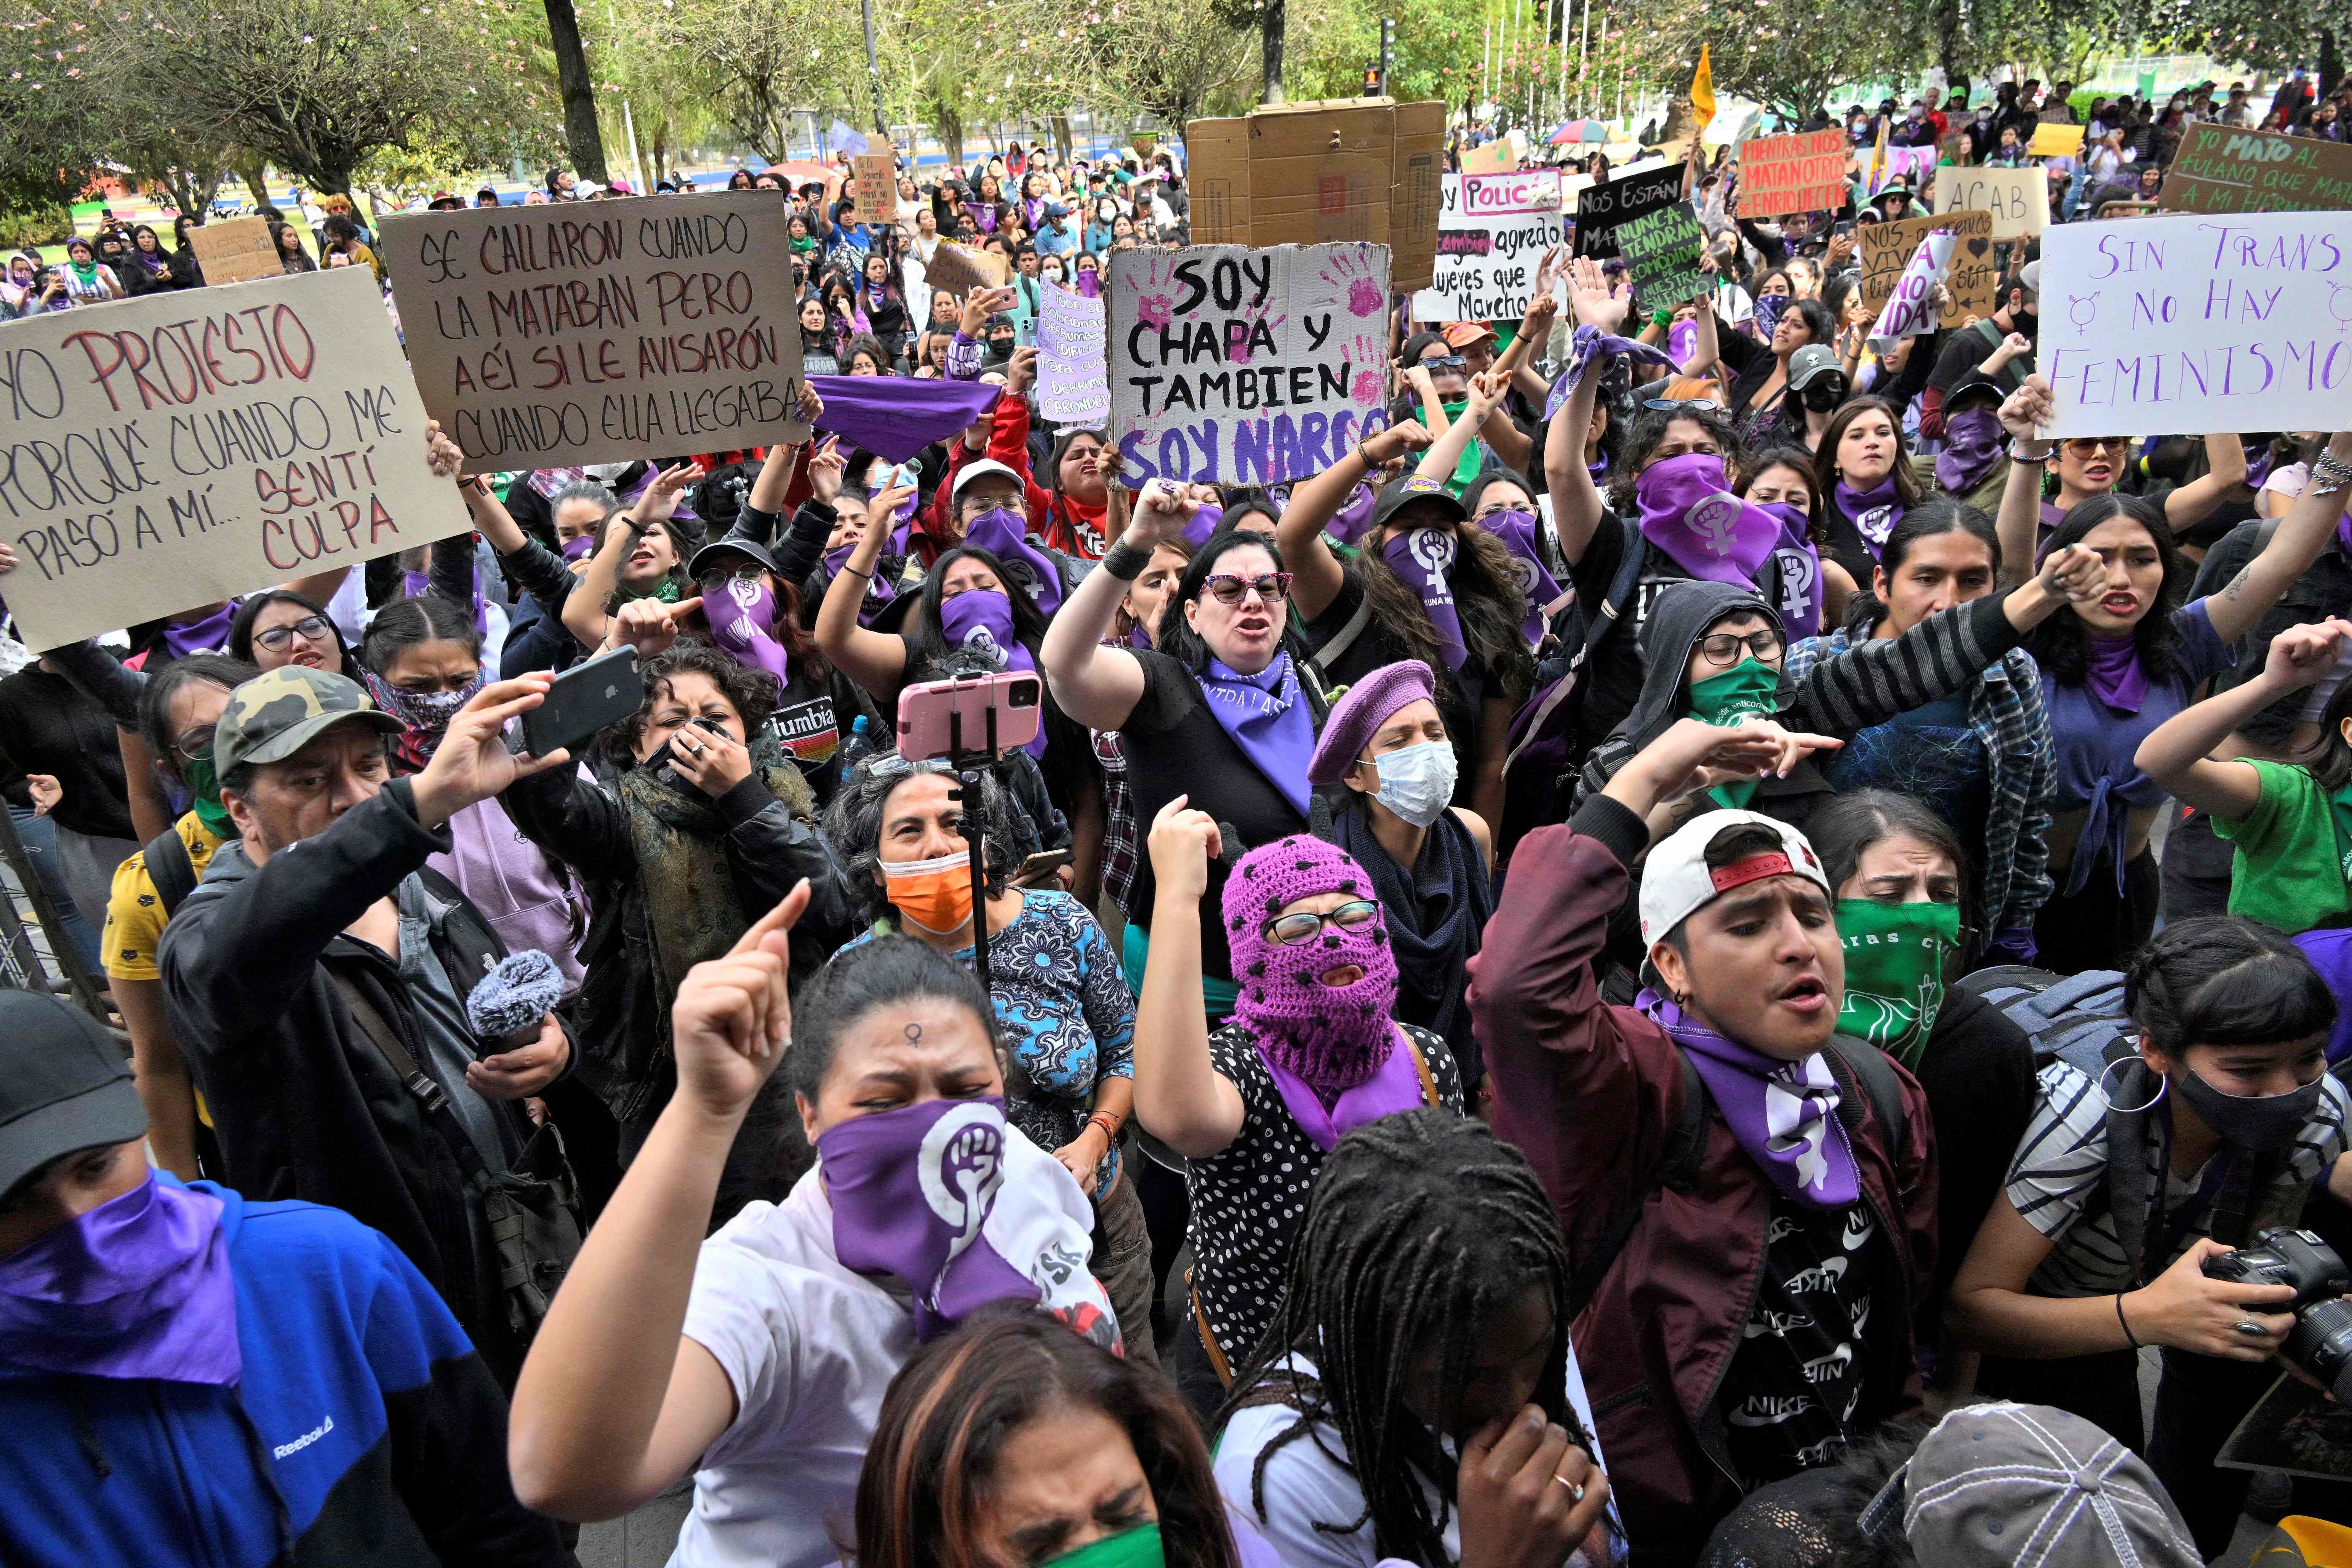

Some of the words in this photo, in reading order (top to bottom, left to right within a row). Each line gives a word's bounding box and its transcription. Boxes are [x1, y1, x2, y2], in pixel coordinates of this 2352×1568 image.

[857, 158, 864, 169] Si
[866, 158, 873, 169] la
[1741, 136, 1807, 162] MIENTRAS
[1811, 132, 1842, 153] NOS
[2196, 129, 2221, 151] YO
[2222, 134, 2292, 162] MATO
[2293, 146, 2319, 169] AL
[1745, 159, 1801, 190] MATAN
[1804, 155, 1845, 183] OTROS
[2181, 154, 2258, 182] FULANO
[2263, 169, 2305, 190] QUE
[1579, 191, 1613, 215] NOS
[1621, 180, 1678, 209] ESTÁN
[1739, 203, 1751, 215] SE
[1752, 184, 1845, 215] ENRIQUECEN
[2181, 184, 2198, 205] A
[2207, 188, 2233, 210] MI
[1495, 217, 1559, 260] agredo
[1616, 205, 1681, 243] NUNCA
[1622, 217, 1701, 258] TENDRAN
[420, 229, 467, 283] SE
[480, 219, 622, 275] CALLARON
[639, 212, 748, 260] CUANDO
[1628, 241, 1701, 283] COMODIDAD
[1863, 248, 1915, 273] VIV
[2089, 234, 2166, 279] SIN
[2198, 223, 2341, 272] TRANS
[1171, 254, 1271, 316] SOY
[1433, 269, 1483, 296] ujeres
[1494, 267, 1525, 295] que
[1643, 267, 1702, 299] NUESTRO
[1662, 267, 1675, 277] DE
[1893, 275, 1927, 301] NO
[434, 296, 479, 340] LA
[487, 273, 639, 339] MATABAN
[646, 270, 753, 326] PERO
[1040, 278, 1051, 300] SI
[1054, 289, 1082, 311] TODO
[1087, 303, 1105, 314] SE
[1644, 281, 1709, 311] SILENCIO
[2133, 288, 2177, 330] NO
[2204, 278, 2282, 324] HAY
[455, 356, 477, 396] A
[578, 338, 626, 383] LE
[638, 315, 778, 379] AVISARÓN
[1127, 318, 1277, 369] CHAPA
[1303, 312, 1331, 352] Y
[0, 348, 64, 420] YO
[60, 303, 318, 413] PROTESTO
[1040, 355, 1075, 375] Para
[2049, 340, 2352, 409] FEMINISMO
[1129, 362, 1351, 416] TAMBIEN
[170, 395, 331, 476] CUANDO
[344, 384, 401, 442] ME
[455, 402, 589, 460] CUANDO
[601, 392, 663, 444] ELLA
[668, 377, 798, 436] LLEGABA
[1118, 418, 1219, 490] SOY
[1402, 479, 1438, 491] LAKERS
[17, 509, 120, 580] PASÓ
[136, 506, 162, 549] A
[255, 444, 376, 515] SENTÍ
[1348, 498, 1363, 509] MENOS
[261, 493, 399, 570] CULPA
[662, 581, 672, 593] por
[1427, 597, 1444, 607] UNA
[1748, 1395, 1810, 1415] NIKE
[273, 1426, 324, 1460] Reebok
